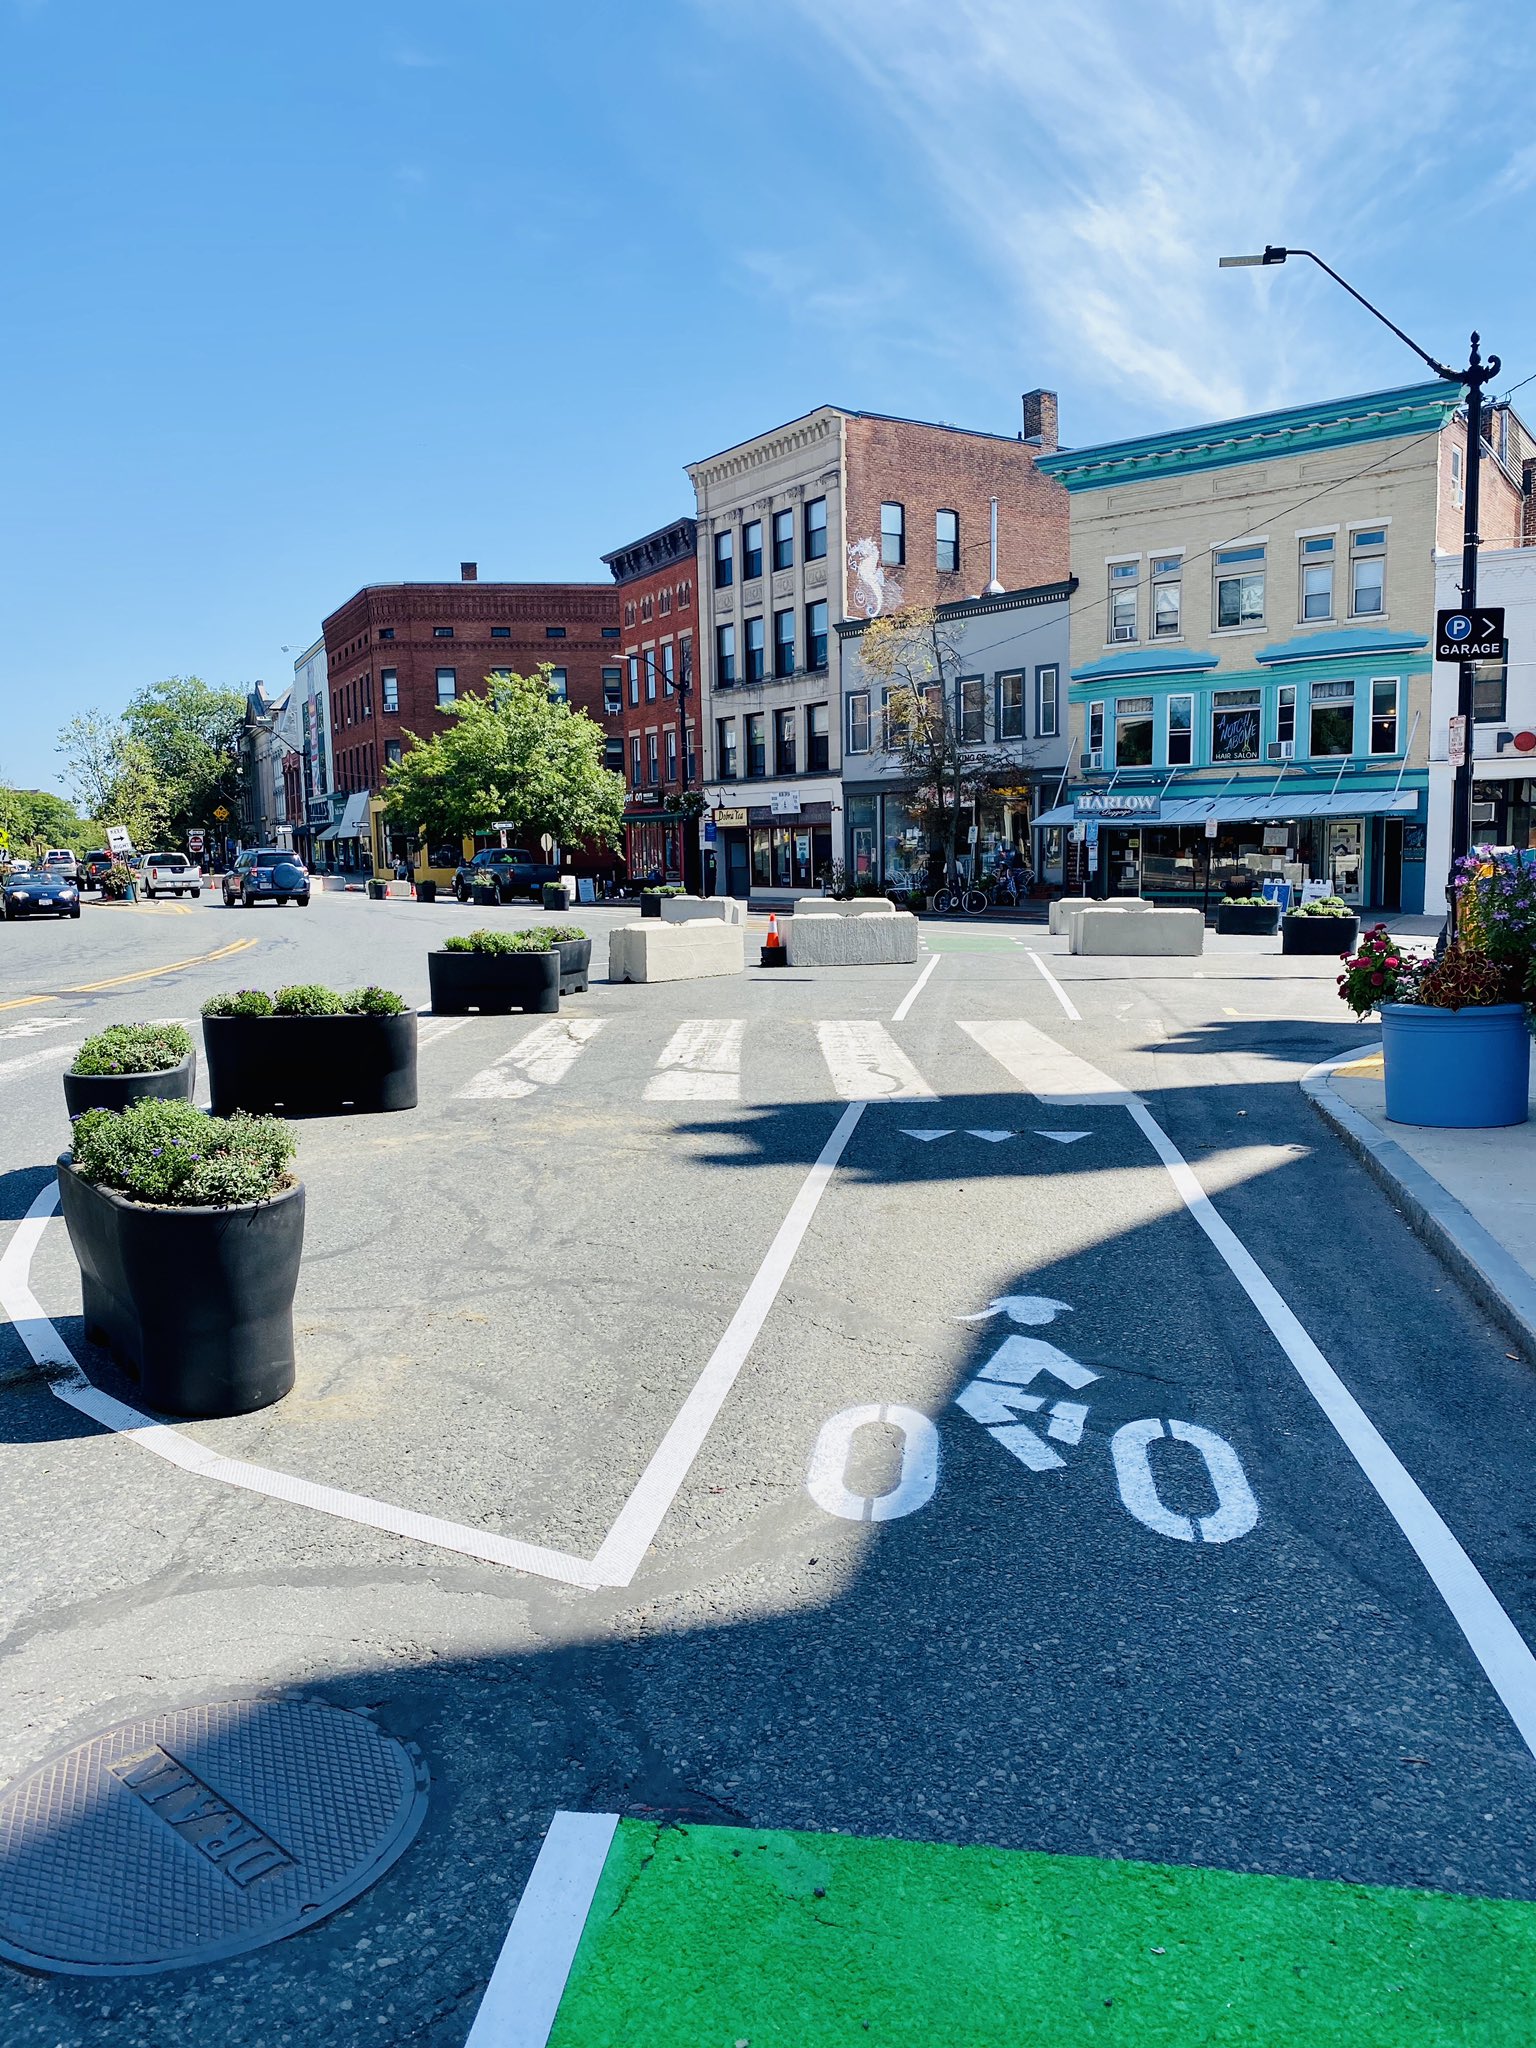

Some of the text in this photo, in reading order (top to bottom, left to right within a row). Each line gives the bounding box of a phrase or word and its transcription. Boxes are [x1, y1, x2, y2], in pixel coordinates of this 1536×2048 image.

[1453, 620, 1466, 635] P
[1440, 643, 1500, 655] GARAGE
[1220, 712, 1251, 742] NOTCH
[1224, 719, 1257, 752] ABOVE
[1234, 751, 1258, 759] SALON
[1077, 796, 1156, 810] HARLOW
[718, 809, 745, 821] Dobra Tea
[1101, 809, 1131, 817] Luggage
